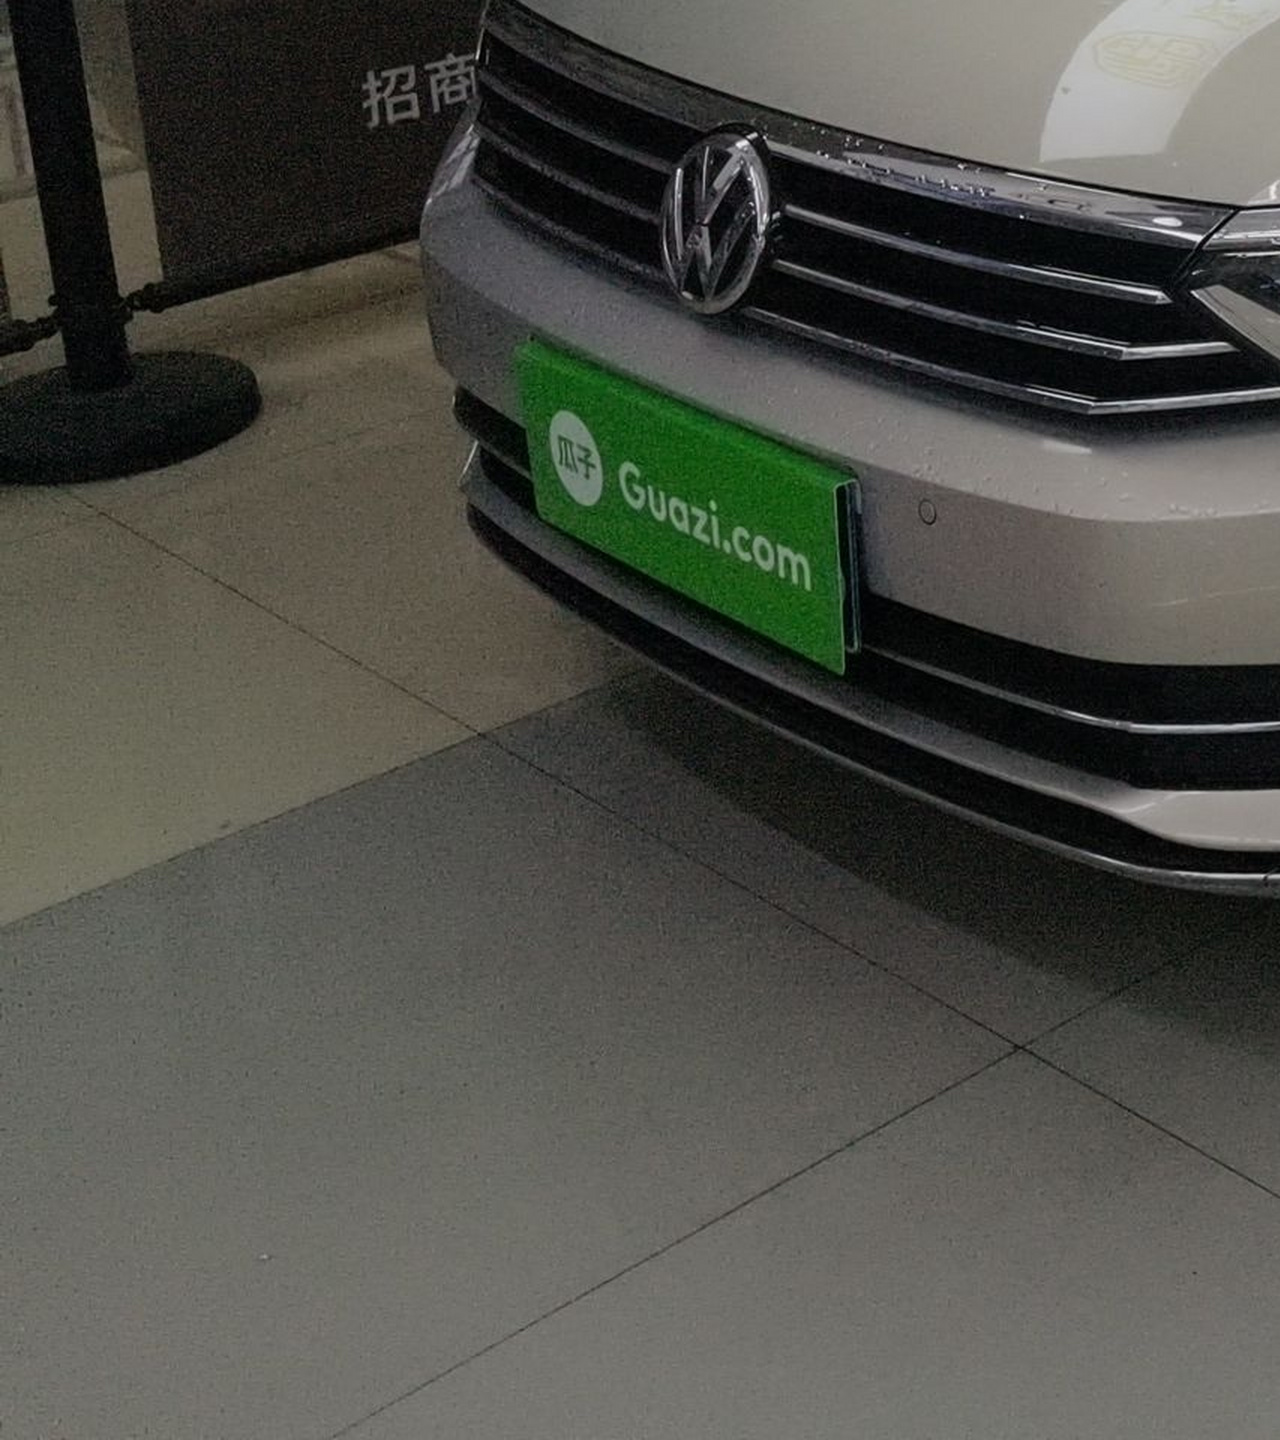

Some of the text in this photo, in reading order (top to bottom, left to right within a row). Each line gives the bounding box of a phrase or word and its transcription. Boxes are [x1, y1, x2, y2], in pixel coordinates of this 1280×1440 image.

[361, 53, 478, 129] 招商
[556, 435, 597, 481] 瓜子
[618, 460, 813, 593] Guazi.com
